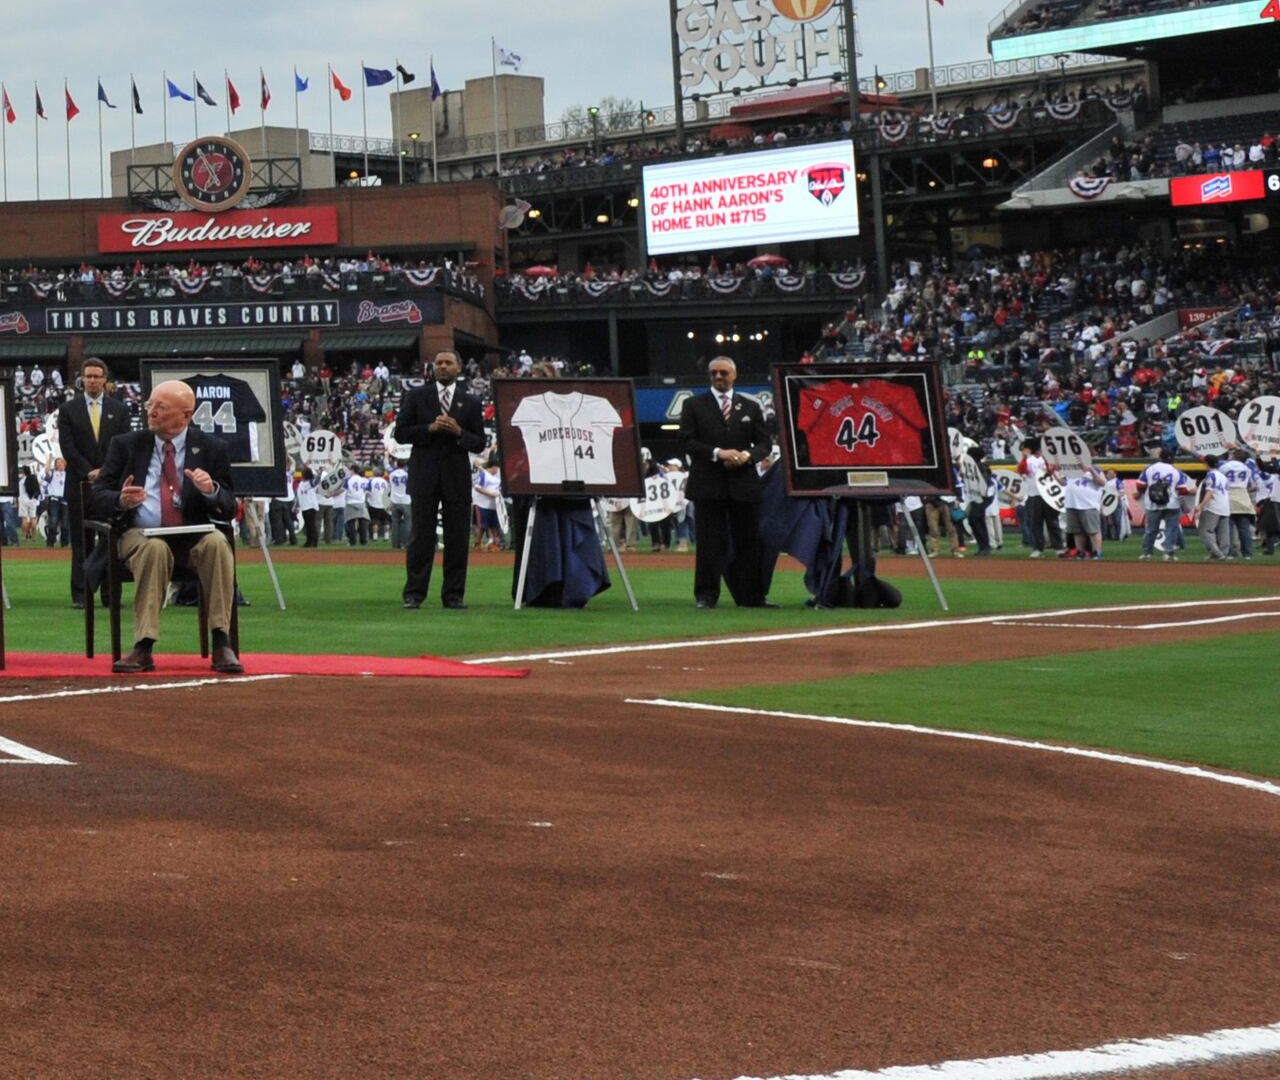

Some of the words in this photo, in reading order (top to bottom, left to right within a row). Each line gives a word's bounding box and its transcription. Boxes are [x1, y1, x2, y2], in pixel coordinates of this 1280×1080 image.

[680, 24, 841, 88] SOUTH
[650, 183, 687, 199] 40TH
[692, 169, 798, 195] ANNIVERSARY
[651, 200, 669, 216] OF
[673, 196, 713, 214] HANK
[718, 189, 784, 208] AARON'S
[122, 217, 311, 247] Budweiser
[652, 218, 692, 232] HOME
[696, 213, 726, 228] RUN
[730, 208, 766, 224] #715
[51, 311, 100, 329] THIS
[115, 309, 137, 328] IS
[150, 307, 227, 326] BRAVES
[242, 304, 335, 324] COUNTRY
[357, 299, 412, 322] Braves
[196, 386, 230, 399] AARON
[192, 401, 237, 433] 44
[1180, 412, 1224, 437] 601
[1247, 402, 1280, 426] 21
[306, 435, 336, 452] 691
[539, 427, 594, 443] MOREHOUSE
[836, 412, 880, 452] 44
[574, 445, 595, 459] 44
[1044, 436, 1082, 455] 576
[1151, 471, 1174, 485] 44
[1225, 469, 1246, 482] 44
[648, 483, 670, 502] 38
